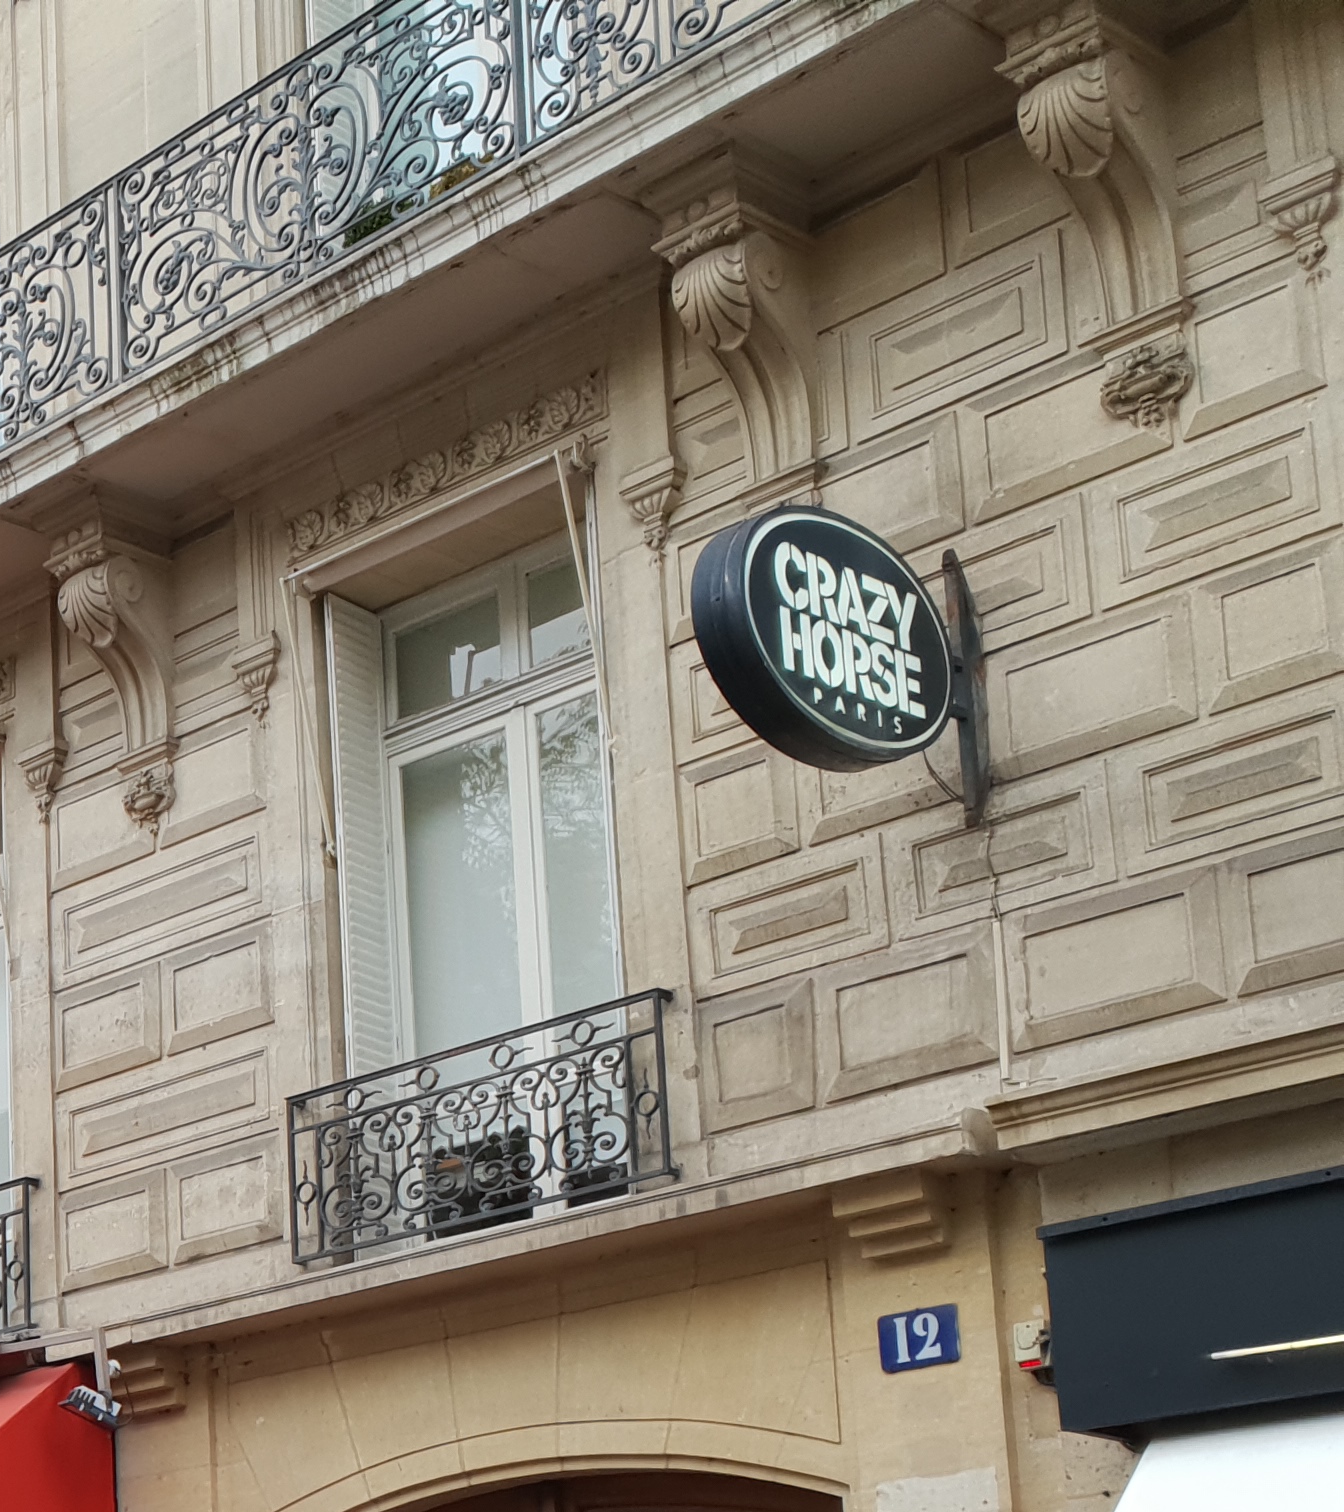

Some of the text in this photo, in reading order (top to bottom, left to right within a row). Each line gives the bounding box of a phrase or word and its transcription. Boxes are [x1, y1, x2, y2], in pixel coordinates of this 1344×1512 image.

[774, 541, 918, 651] CRAZY
[779, 605, 927, 719] HORSE
[813, 687, 903, 735] PARIS
[893, 1312, 942, 1364] 12
